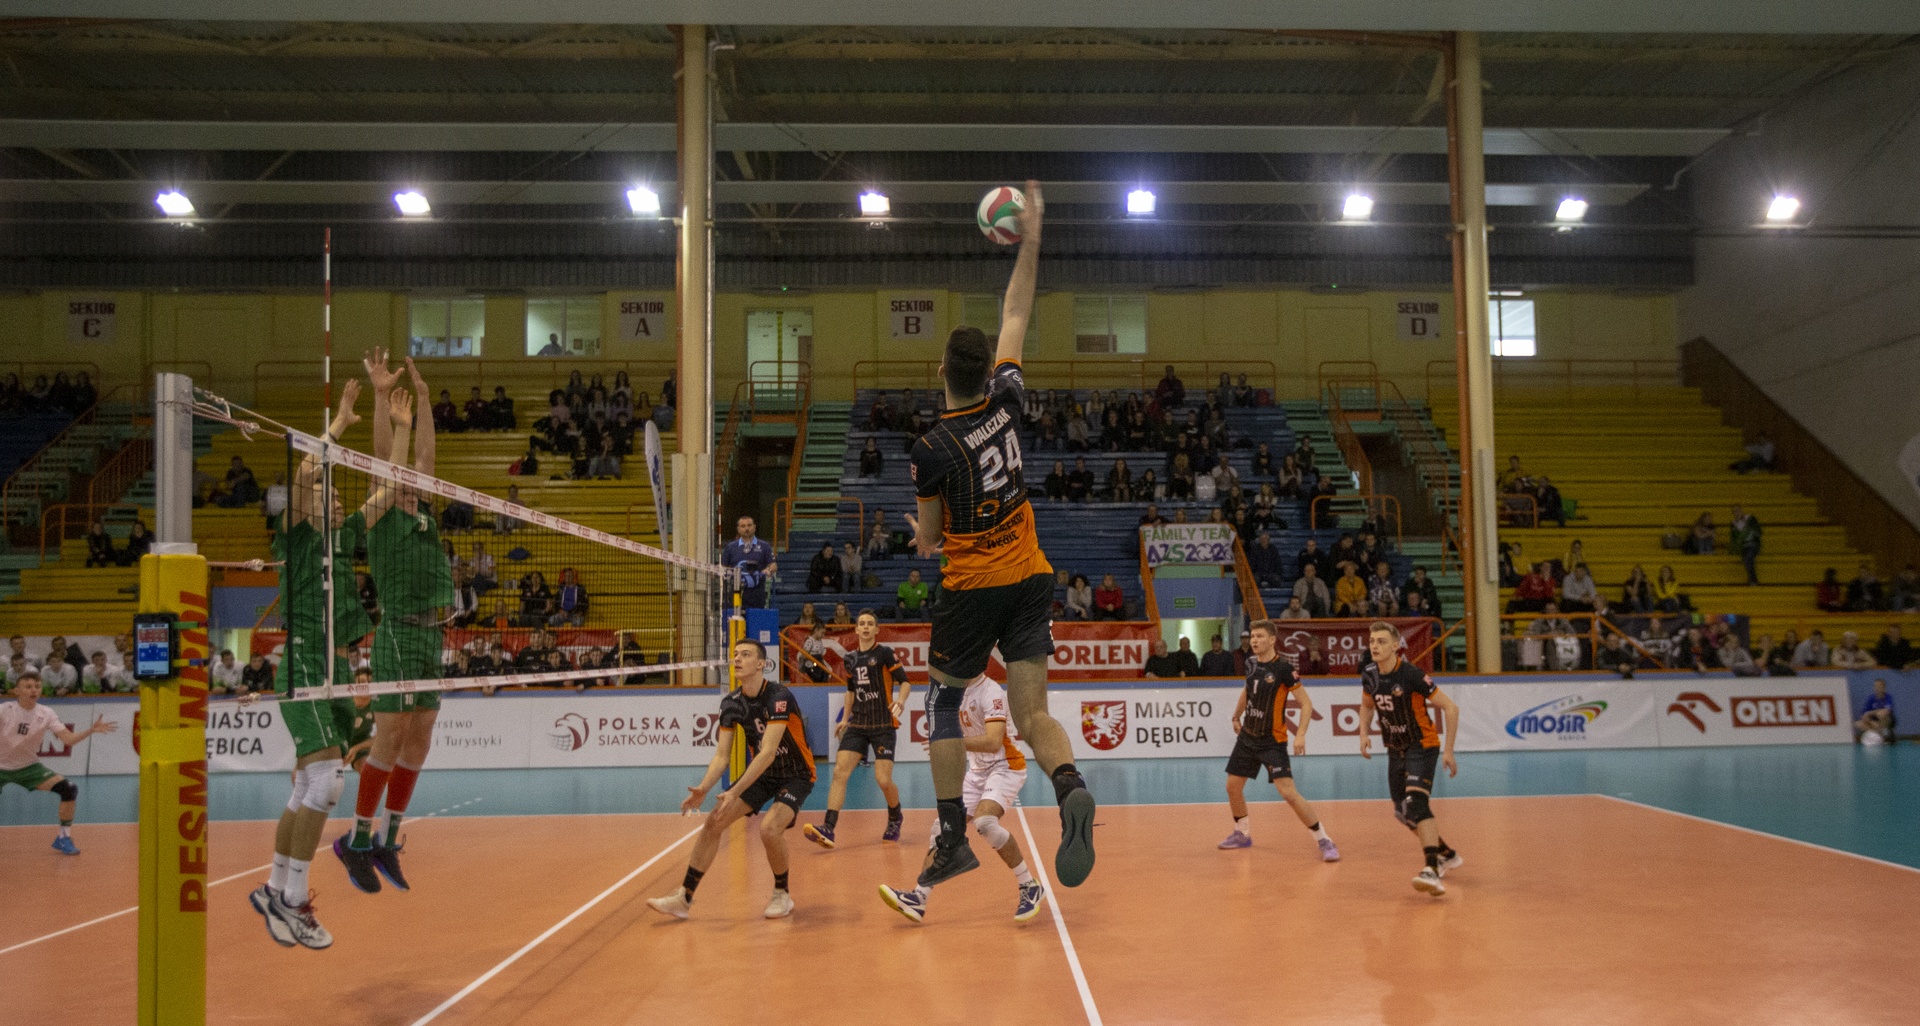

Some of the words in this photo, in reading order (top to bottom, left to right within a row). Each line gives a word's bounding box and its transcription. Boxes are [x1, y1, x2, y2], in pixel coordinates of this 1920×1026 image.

[69, 302, 115, 314] SEKTOR
[621, 301, 664, 314] SEKTOR
[890, 300, 934, 312] SEKTOR
[1397, 302, 1439, 314] SEKTOR
[84, 319, 101, 337] C
[635, 318, 651, 336] A
[904, 316, 921, 334] B
[1411, 318, 1427, 335] D
[964, 407, 1012, 450] WALCZAK
[979, 428, 1022, 492] 24
[1142, 527, 1197, 541] FAMILY
[1327, 636, 1409, 650] POLA
[1053, 644, 1143, 665] ORLEN
[856, 666, 869, 681] 12
[1252, 679, 1259, 694] 1
[1135, 700, 1213, 719] MIASTO
[1375, 695, 1394, 711] 25
[205, 711, 272, 729] IASTO
[1735, 700, 1832, 725] ORLEN
[17, 722, 30, 736] 15
[599, 717, 681, 730] POLSKA
[445, 735, 502, 748] Turystyki
[598, 731, 681, 746] SIATKÓWKA
[1136, 726, 1209, 748] DĘBICA
[205, 737, 263, 760] ĘBICA
